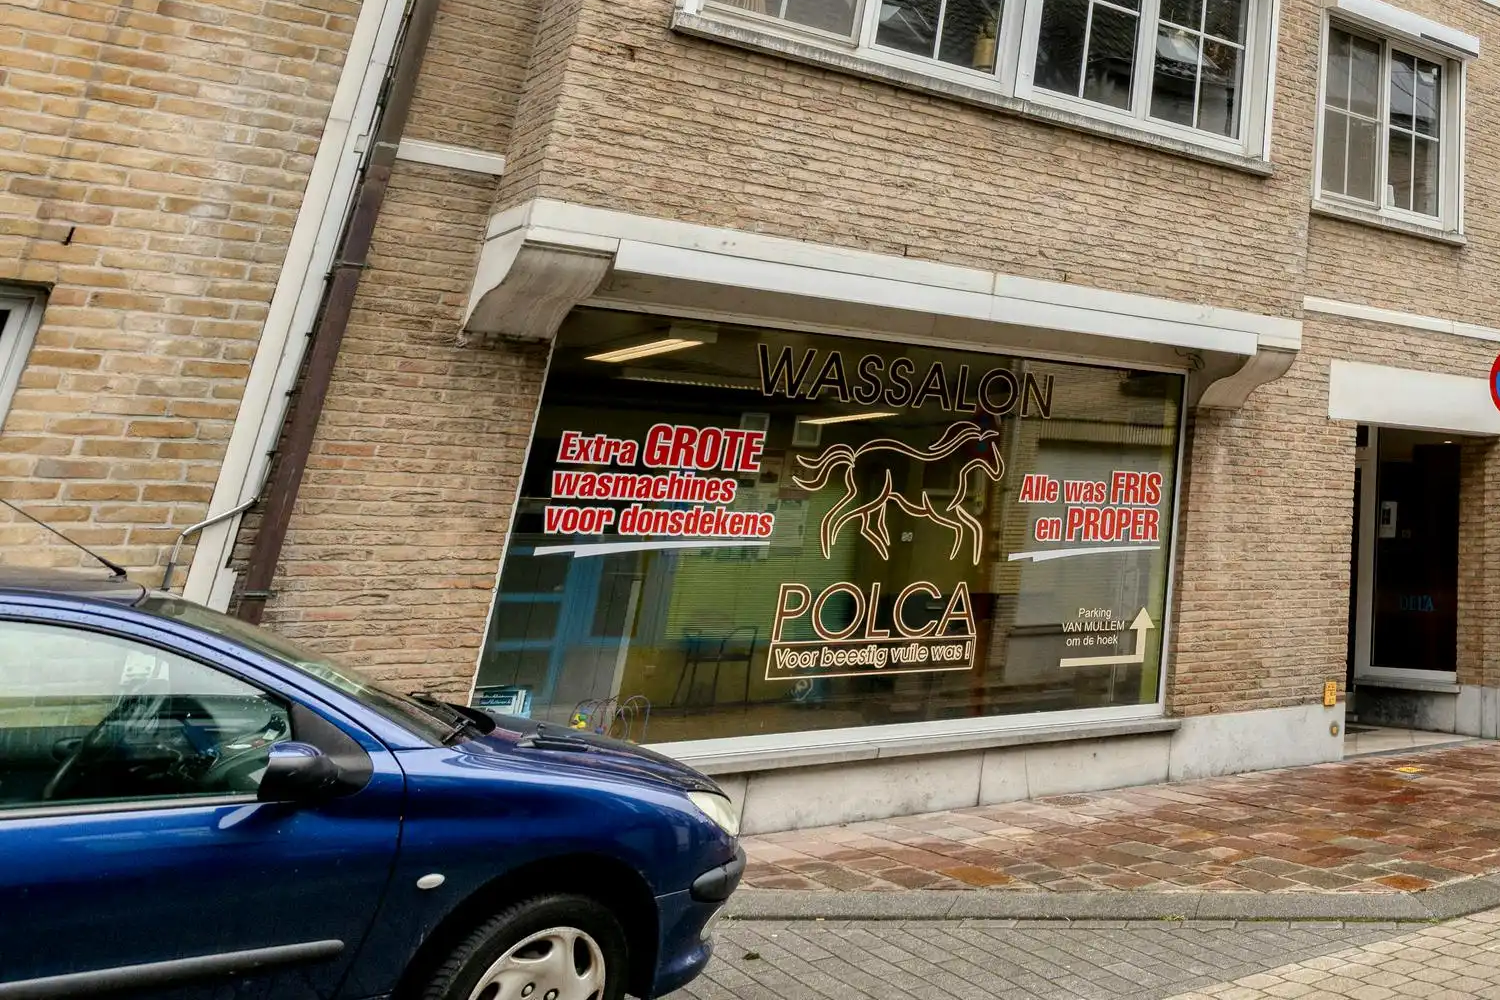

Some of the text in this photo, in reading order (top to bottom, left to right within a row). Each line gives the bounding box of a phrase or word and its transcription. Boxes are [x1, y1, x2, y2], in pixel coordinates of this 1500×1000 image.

[757, 343, 1055, 419] WASSALON
[556, 423, 767, 472] Extra GROTE
[551, 469, 737, 504] wasmachines
[1018, 470, 1163, 506] Alle was FRIS
[544, 503, 775, 537] voor donsdekens
[1035, 506, 1160, 542] en PROPER
[772, 581, 976, 642] POLCA
[1062, 620, 1125, 633] VAN MULLEM
[1078, 607, 1112, 620] Parking
[775, 648, 819, 669] Voor
[820, 644, 889, 668] beestig
[890, 642, 928, 663] vuile
[931, 643, 962, 660] was
[1066, 634, 1118, 646] om de hoek
